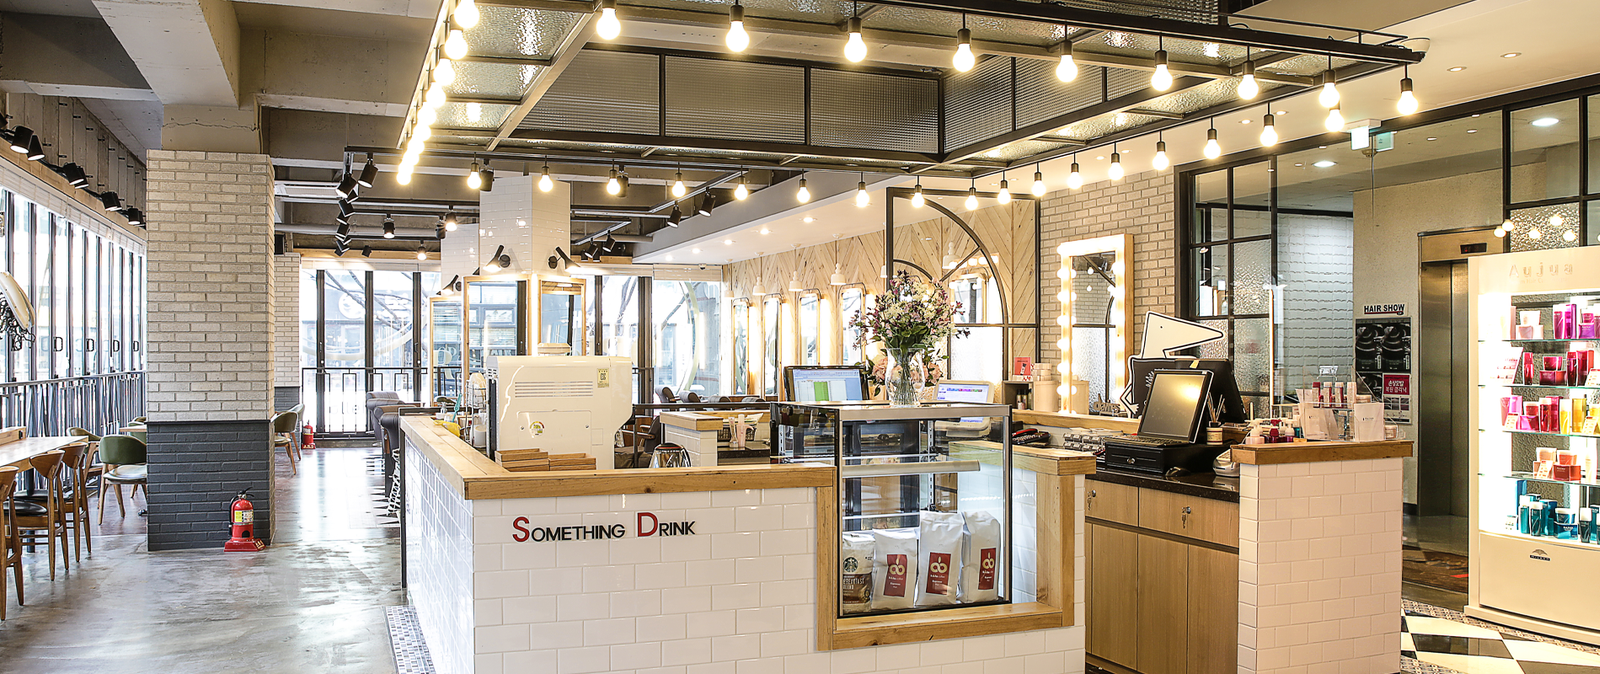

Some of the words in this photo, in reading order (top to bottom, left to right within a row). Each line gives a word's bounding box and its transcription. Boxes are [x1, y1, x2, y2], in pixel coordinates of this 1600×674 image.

[1509, 261, 1573, 278] Aujua
[1363, 304, 1382, 313] HAIR
[1383, 303, 1405, 312] SHOW
[512, 516, 626, 542] SOMETHING
[637, 512, 696, 537] DRINK
